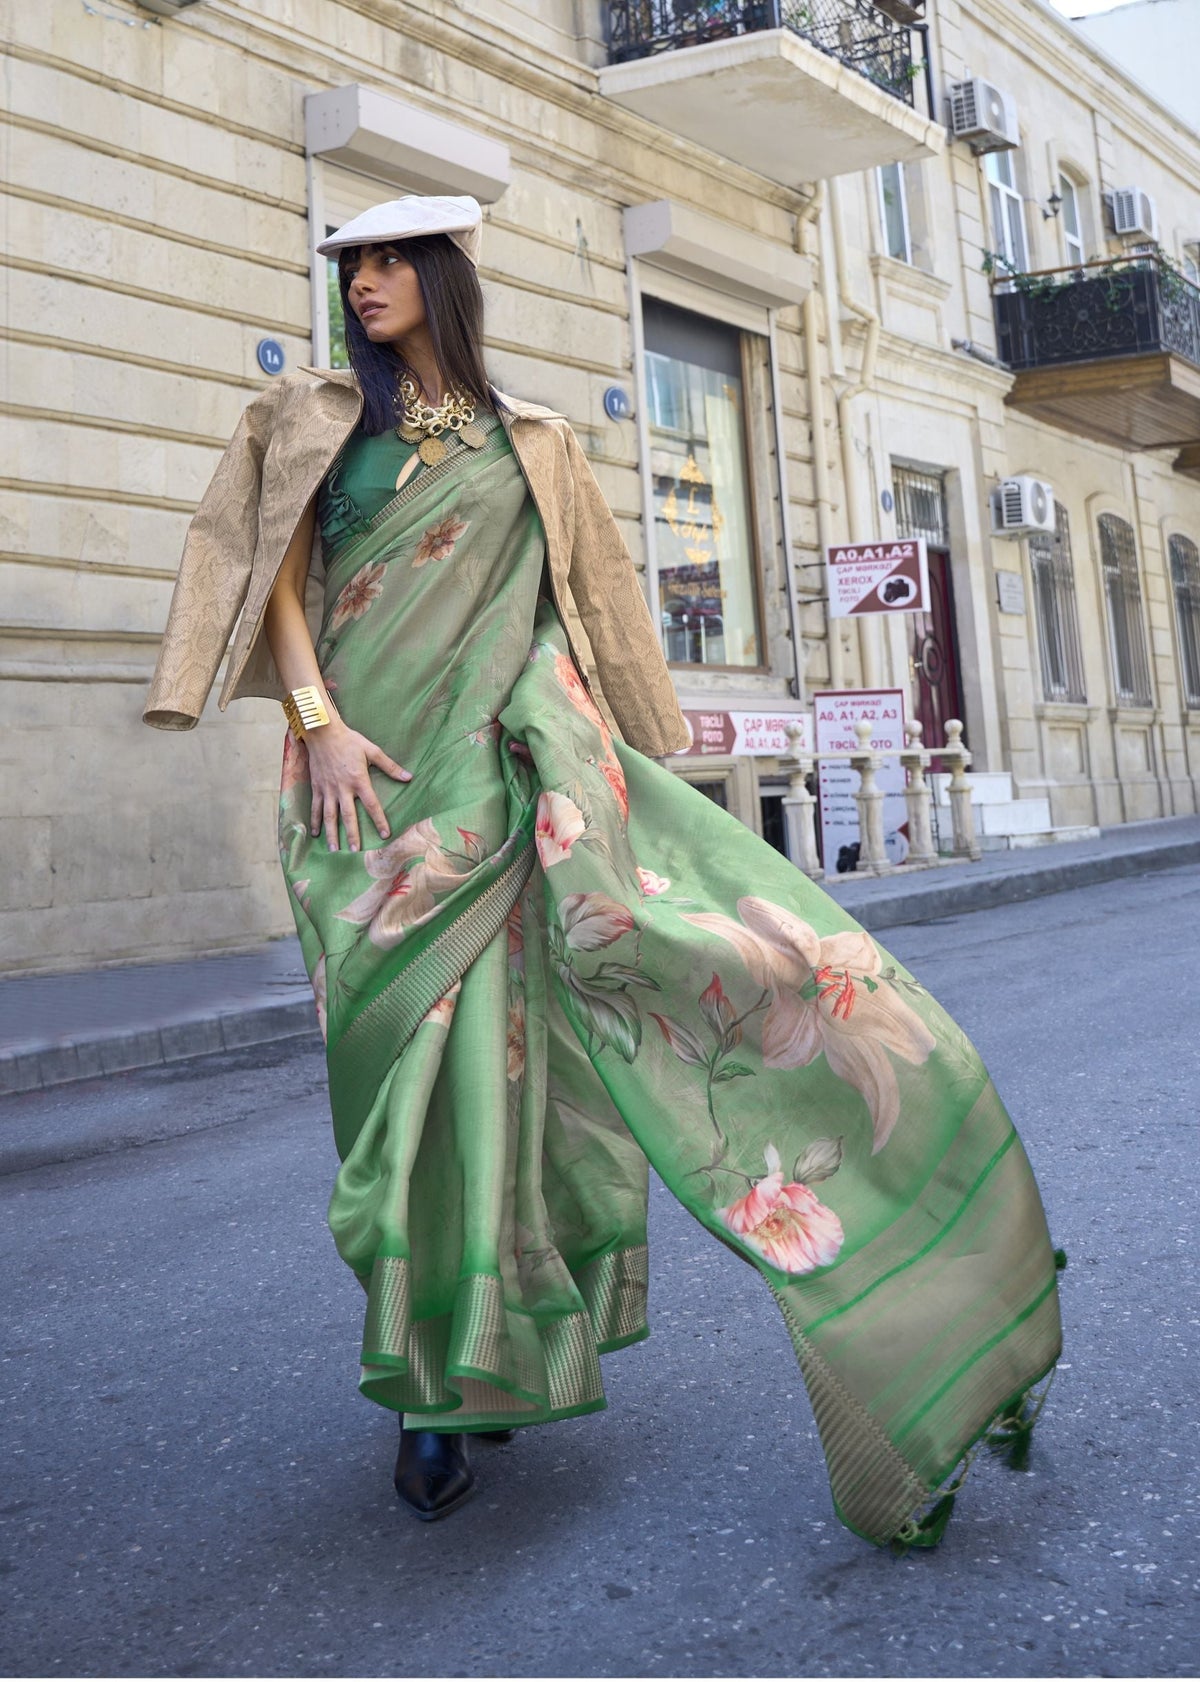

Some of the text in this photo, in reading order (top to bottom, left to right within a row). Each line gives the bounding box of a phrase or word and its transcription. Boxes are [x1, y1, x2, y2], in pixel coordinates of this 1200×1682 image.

[266, 349, 280, 366] 1A
[837, 576, 873, 586] XEROX
[882, 709, 898, 719] A3
[743, 718, 763, 735] ÇAP
[702, 731, 724, 743] FOTO
[829, 739, 893, 750] TƏCİL OTO
